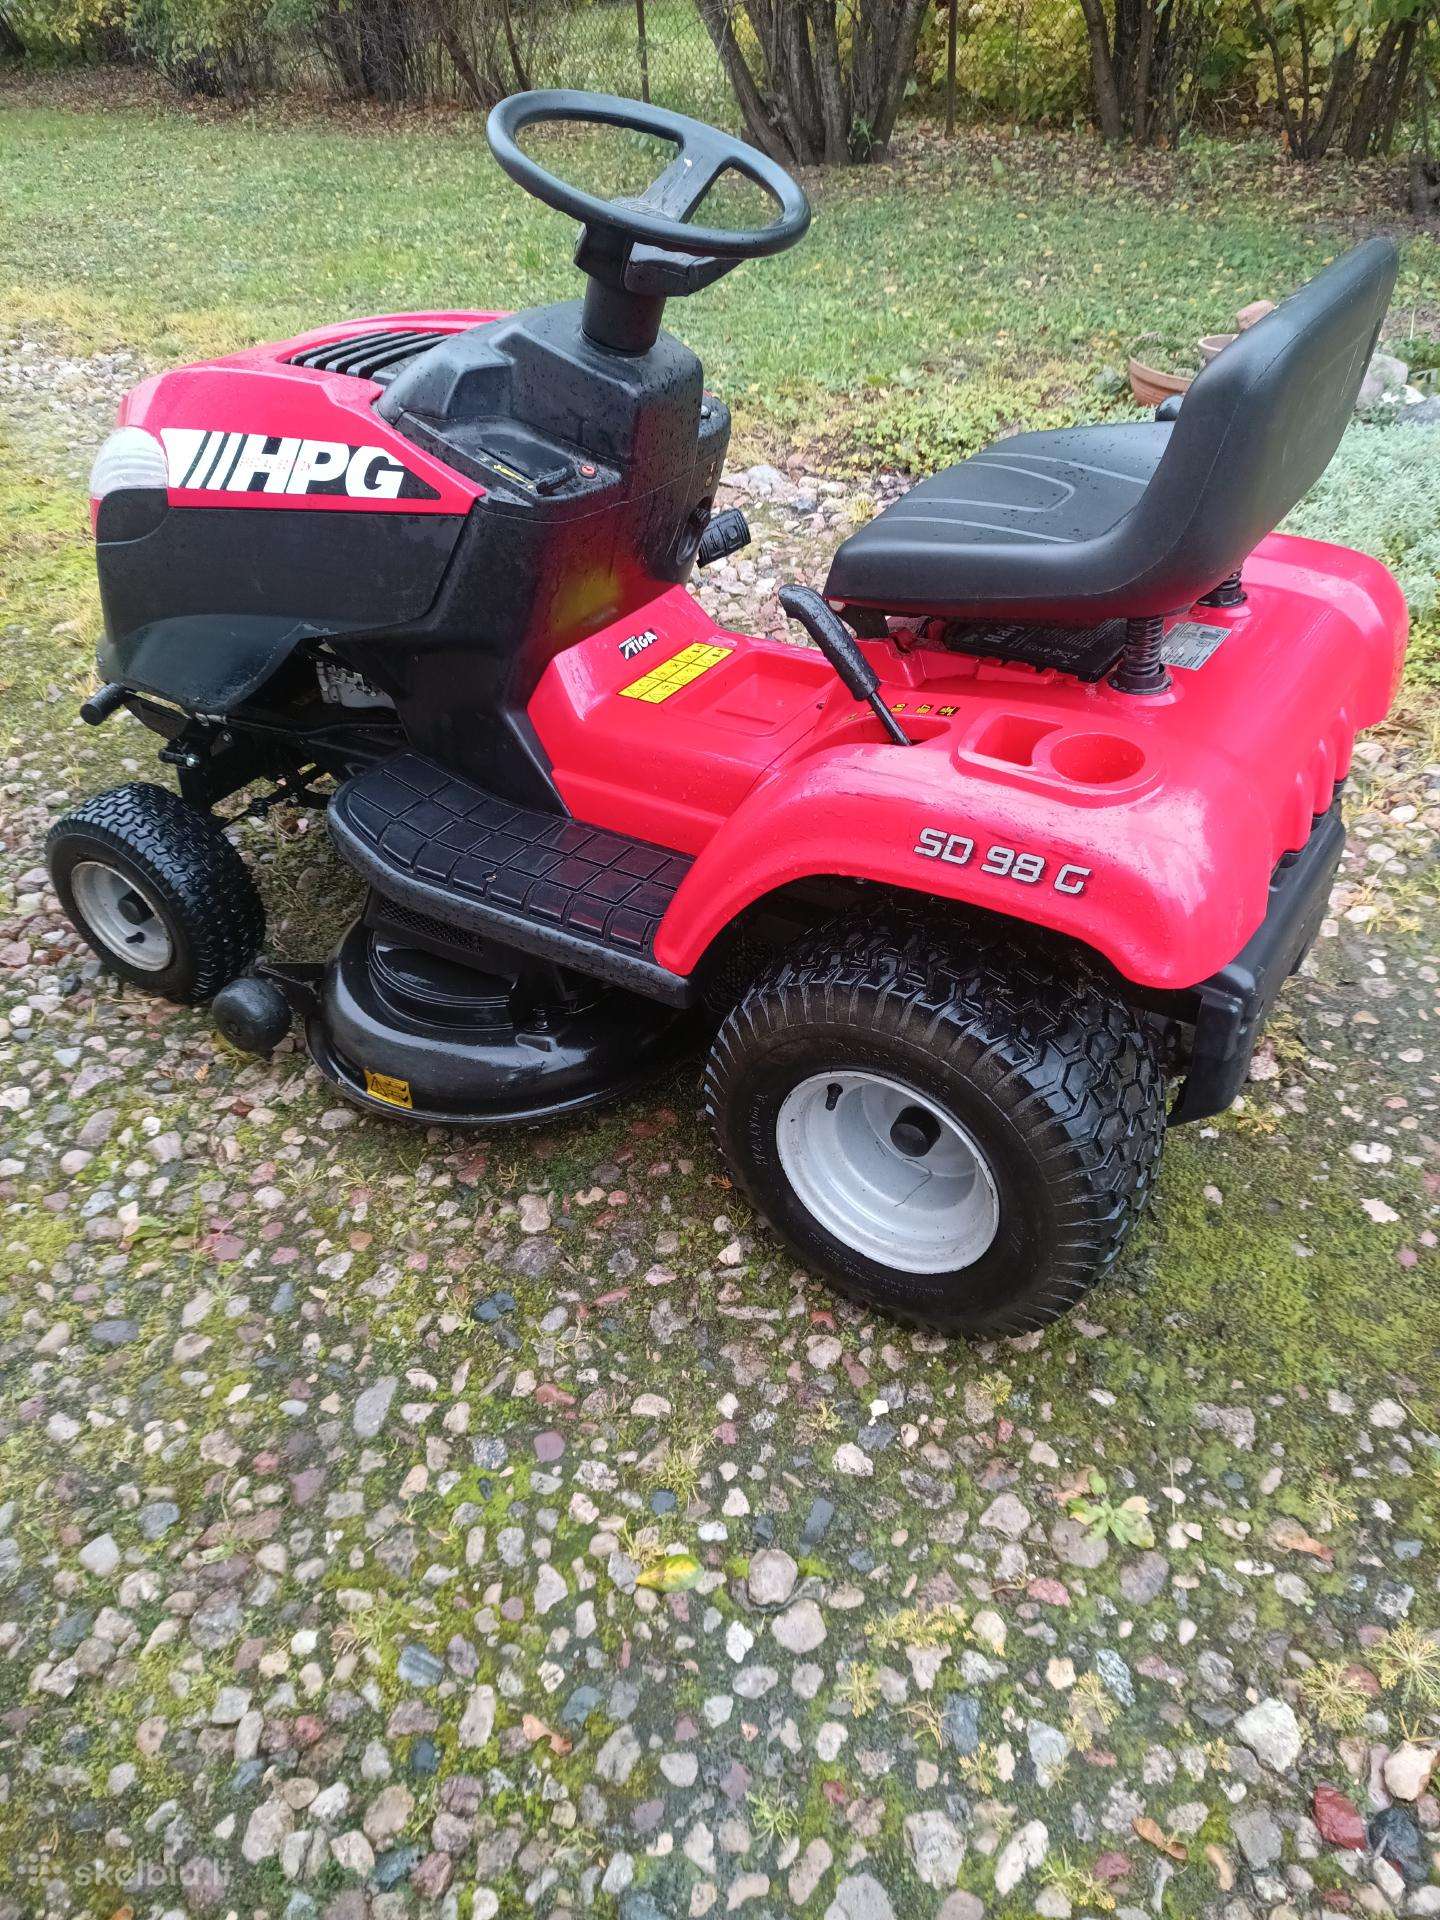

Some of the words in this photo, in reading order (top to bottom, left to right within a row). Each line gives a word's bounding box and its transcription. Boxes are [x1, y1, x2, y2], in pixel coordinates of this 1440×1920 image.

[226, 432, 404, 499] HPG
[618, 631, 658, 660] STIGA
[914, 827, 975, 865] SD
[981, 845, 1046, 884] 98
[1053, 863, 1092, 895] G
